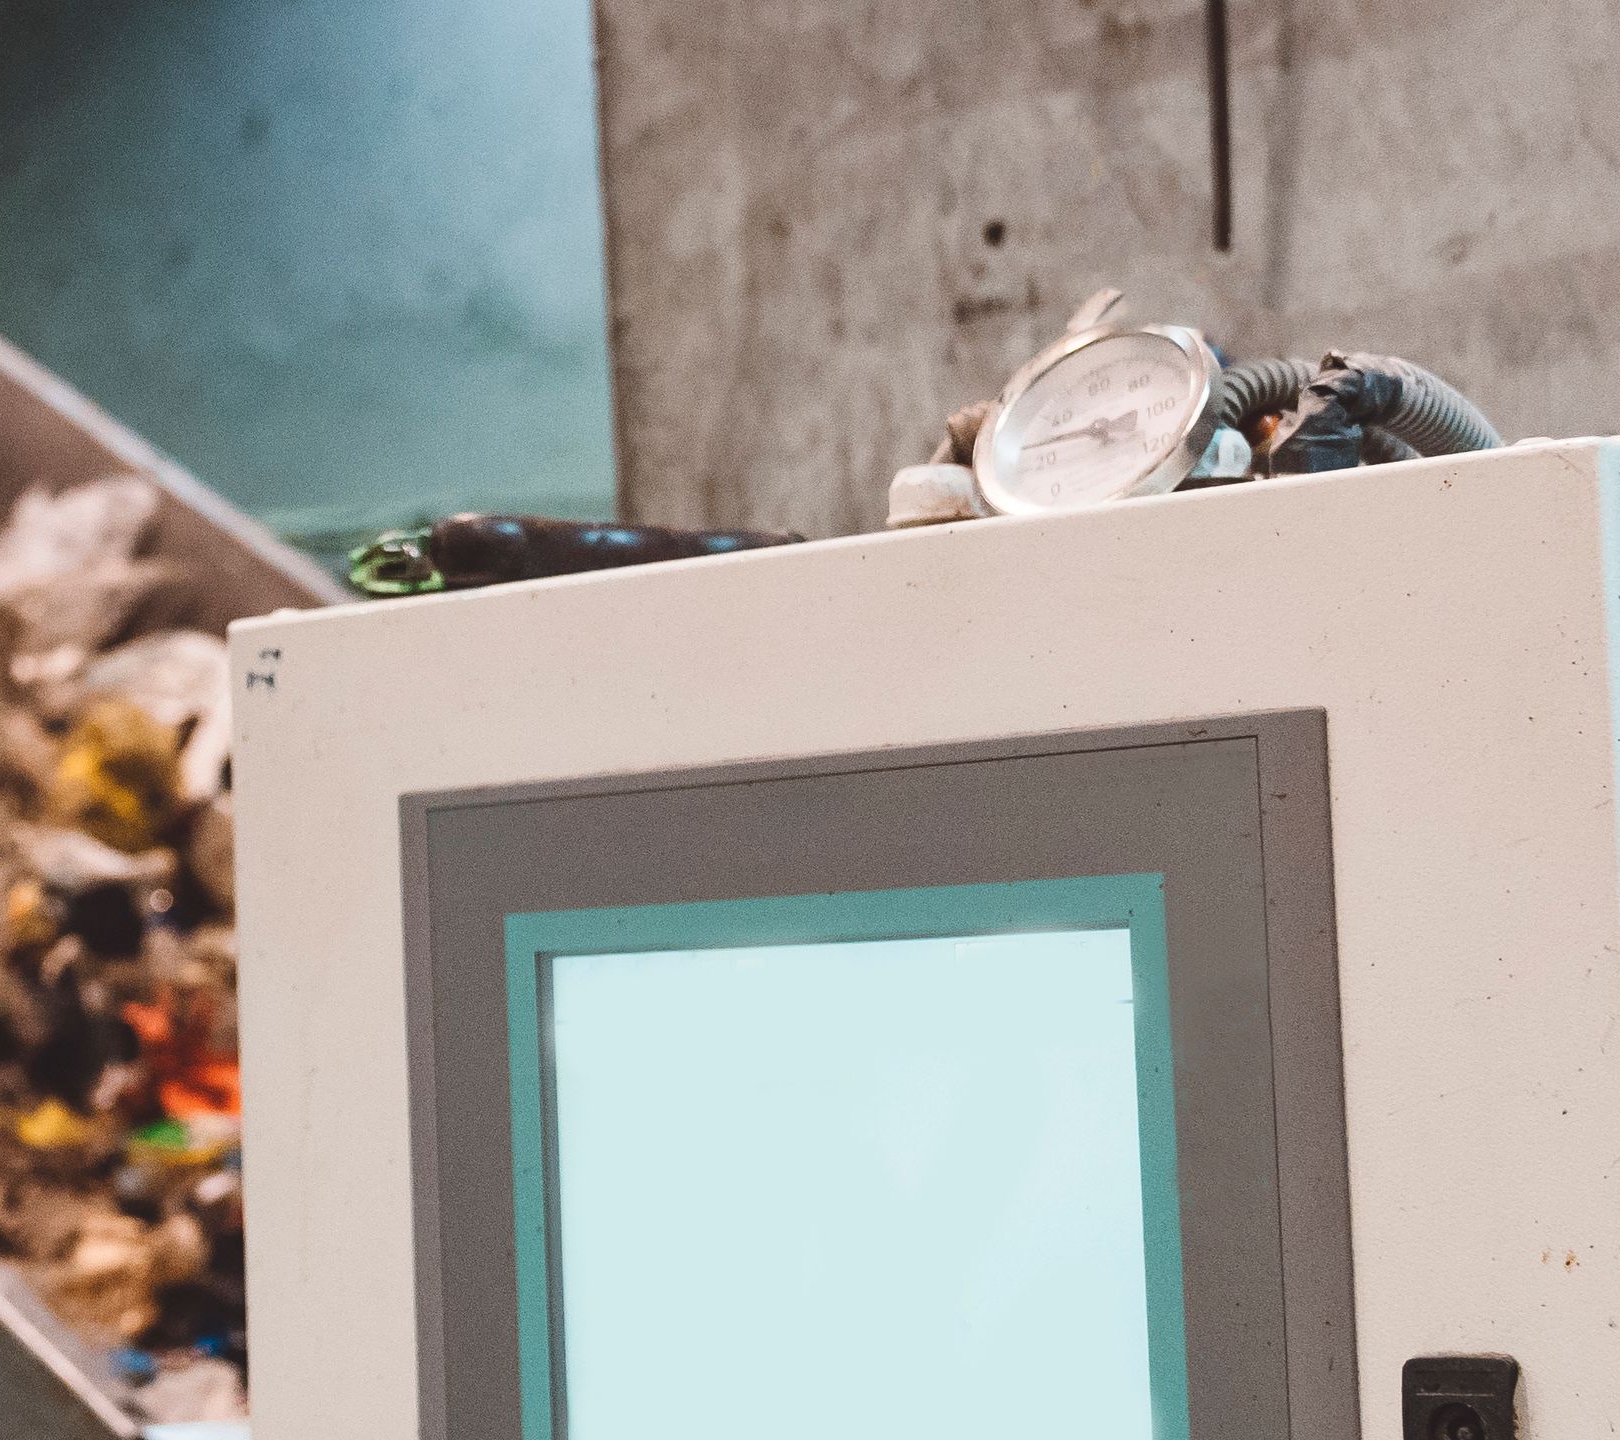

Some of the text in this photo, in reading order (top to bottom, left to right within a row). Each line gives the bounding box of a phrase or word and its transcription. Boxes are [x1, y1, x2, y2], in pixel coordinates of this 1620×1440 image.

[1146, 397, 1176, 419] 100
[1142, 432, 1174, 455] 120
[1050, 482, 1061, 498] 0
